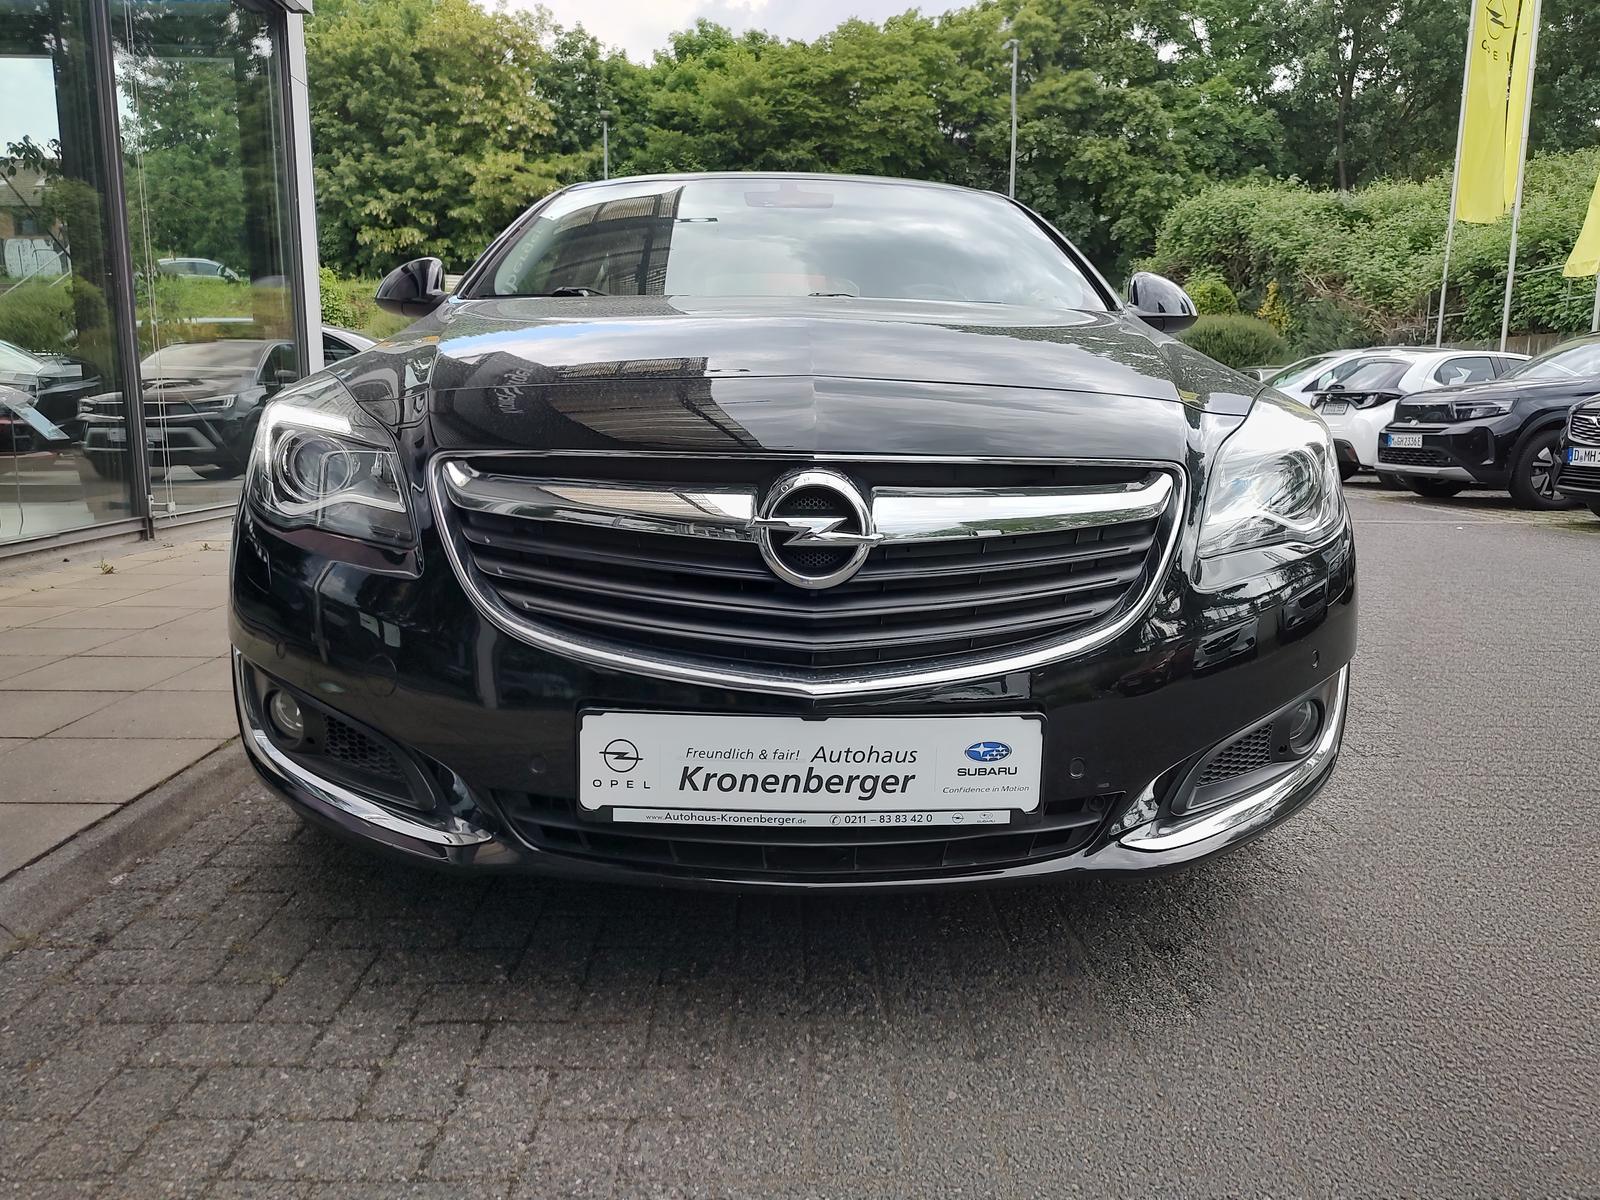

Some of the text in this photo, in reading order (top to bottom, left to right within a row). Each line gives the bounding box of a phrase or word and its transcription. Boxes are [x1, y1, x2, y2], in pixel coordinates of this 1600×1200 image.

[685, 748, 801, 761] Freundlich & fair!
[810, 745, 918, 764] Autohaus
[957, 767, 1018, 777] SUBARU
[592, 779, 651, 789] OPEL
[678, 766, 916, 801] Kronenberger
[942, 785, 1030, 794] Confidence in Motion
[645, 811, 807, 826] www.Autohaus-Kronenberger.de
[844, 814, 867, 824] 0211
[879, 813, 892, 824] 83
[894, 813, 908, 824] 83
[910, 813, 924, 823] 42
[926, 814, 933, 823] 0
